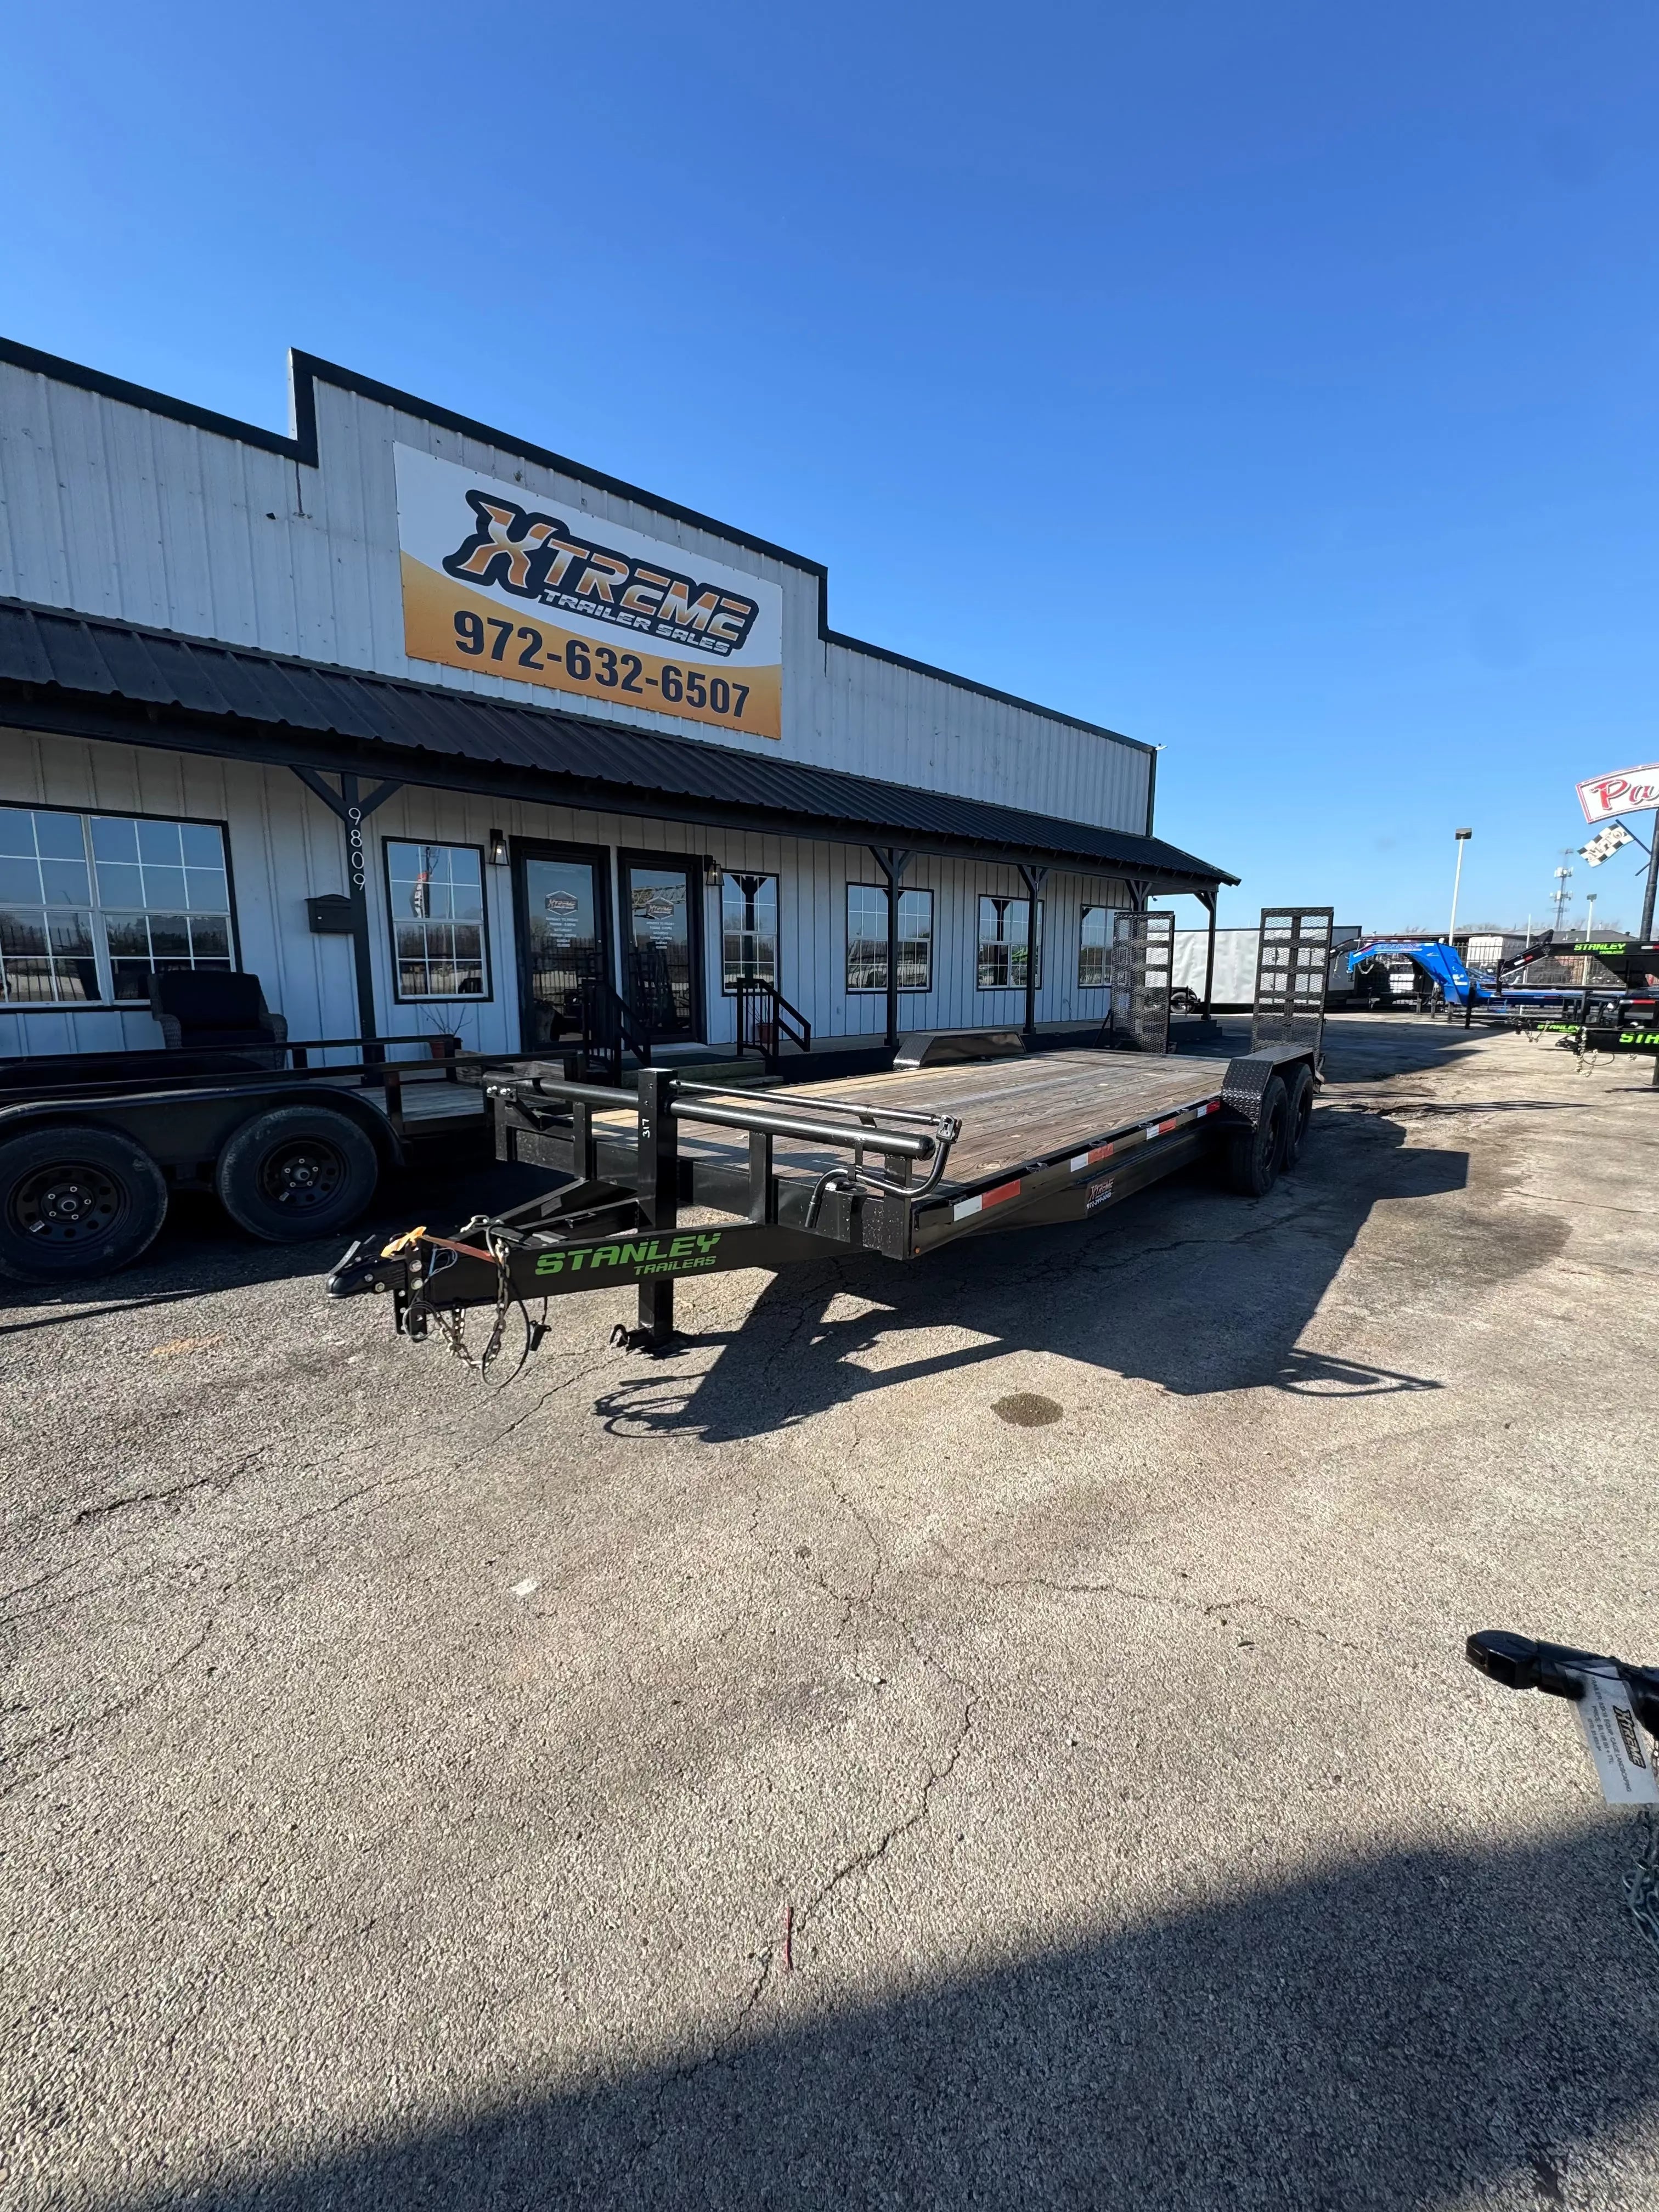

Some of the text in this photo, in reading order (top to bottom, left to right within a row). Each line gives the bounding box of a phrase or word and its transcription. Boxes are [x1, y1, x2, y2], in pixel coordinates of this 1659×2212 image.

[455, 499, 752, 642] XTREME
[543, 588, 731, 653] TRAILER SALES
[453, 610, 750, 718] 972-632-6507
[348, 808, 365, 890] 9809
[1573, 943, 1627, 951] STANLEY
[535, 1233, 721, 1276] STANLEY
[634, 1256, 716, 1276] TRAILERS
[1613, 1705, 1646, 1769] XTREME
[1616, 1754, 1632, 1792] LANDSCAPING
